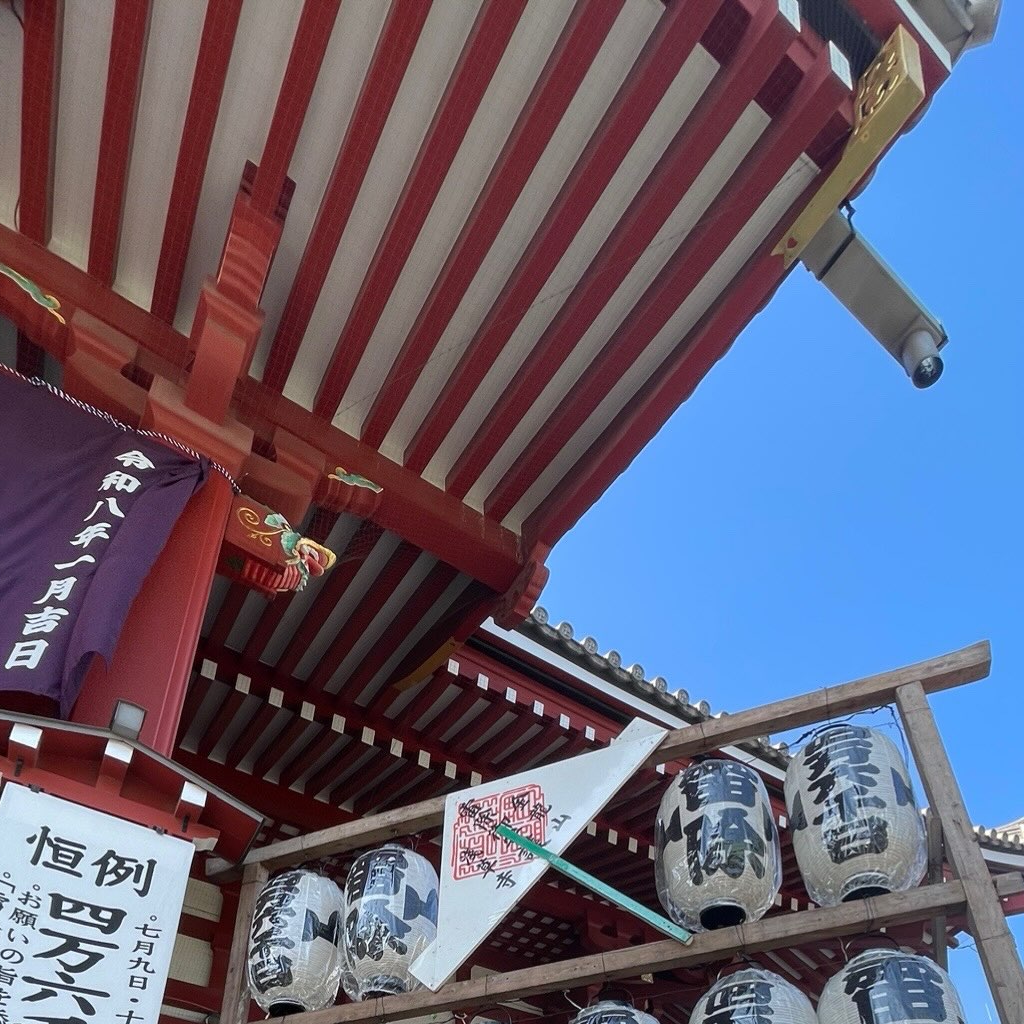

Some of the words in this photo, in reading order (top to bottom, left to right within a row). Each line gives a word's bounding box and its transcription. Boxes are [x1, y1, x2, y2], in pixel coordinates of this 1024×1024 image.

[5, 450, 155, 670] 令和八年一月吉日
[26, 826, 158, 898] 恒例
